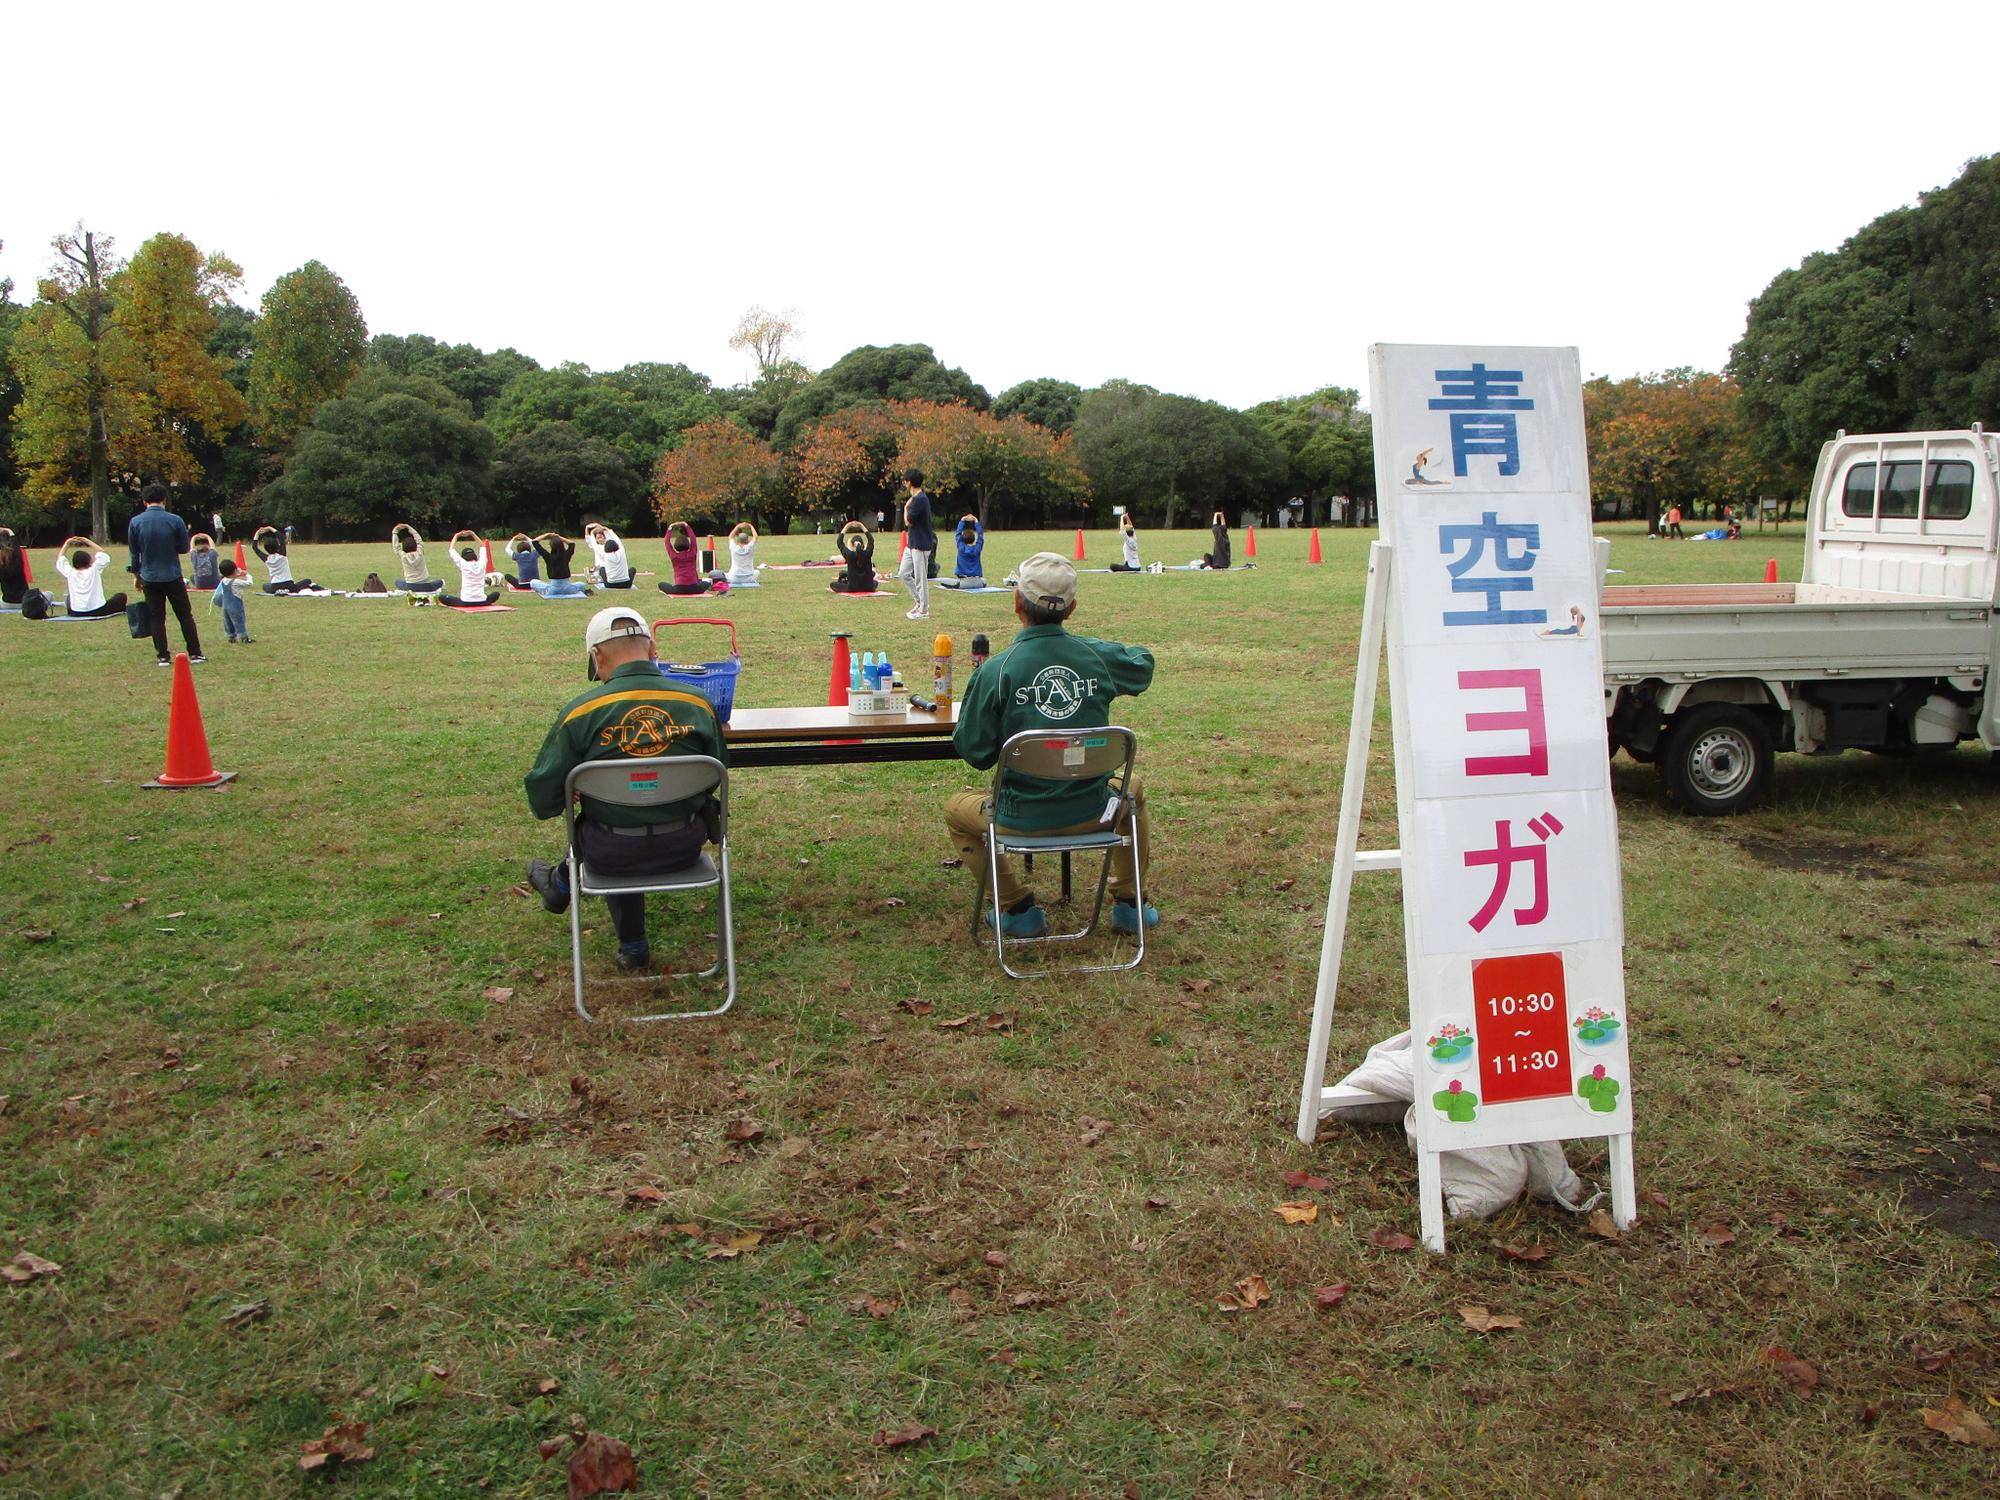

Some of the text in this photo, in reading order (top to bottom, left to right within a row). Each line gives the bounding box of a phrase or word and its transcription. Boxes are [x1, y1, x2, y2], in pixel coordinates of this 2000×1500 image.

[1428, 363, 1564, 933] 青空ヨガ
[1015, 678, 1098, 705] STAFF
[1488, 992, 1555, 1017] 10:30
[1492, 1049, 1559, 1075] 11:30
